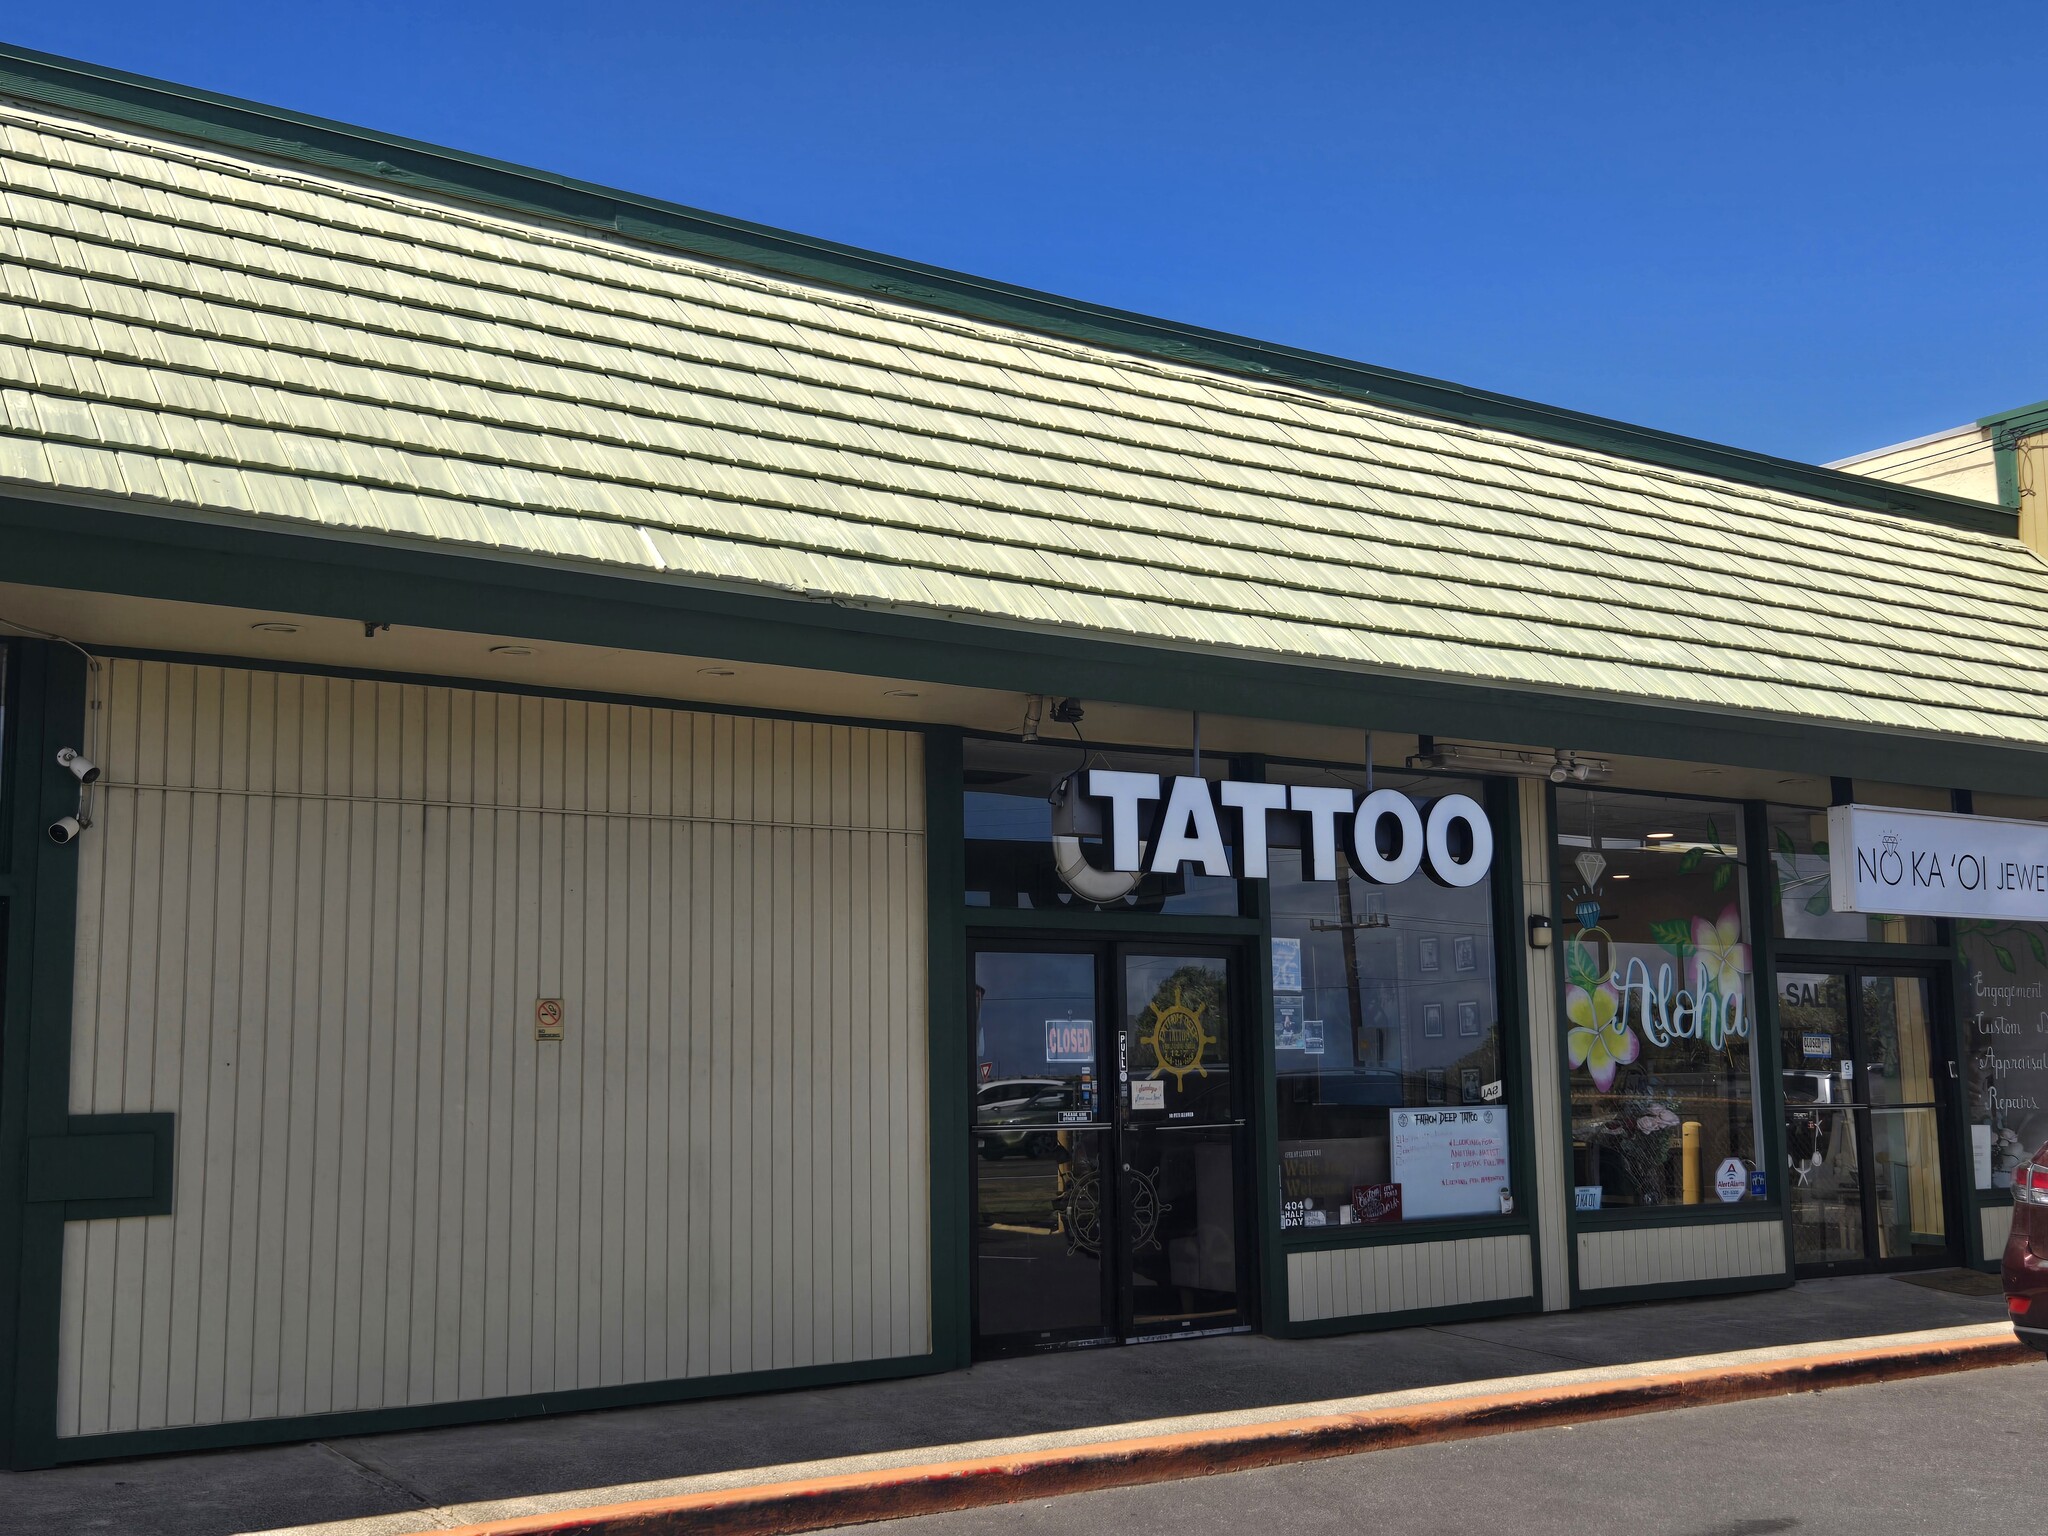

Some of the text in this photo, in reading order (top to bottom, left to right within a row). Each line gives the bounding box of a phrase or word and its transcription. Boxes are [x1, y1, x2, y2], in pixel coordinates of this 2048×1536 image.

[1086, 768, 1495, 889] TATTOO
[1911, 851, 1946, 889] KA
[1996, 862, 2048, 892] JEWE
[1973, 971, 2043, 1007] Engagement
[1610, 956, 1750, 1051] Aloha
[1976, 1011, 2022, 1035] Custom
[1048, 1027, 1091, 1054] CLOSED
[1803, 1037, 1822, 1049] CLOSED
[1985, 1085, 2040, 1117] Repairs
[1438, 1112, 1458, 1125] DEEP
[1459, 1111, 1479, 1125] TATTOO
[1284, 1200, 1304, 1211] 404
[1285, 1210, 1304, 1219] HALF
[1285, 1217, 1304, 1227] DAY
